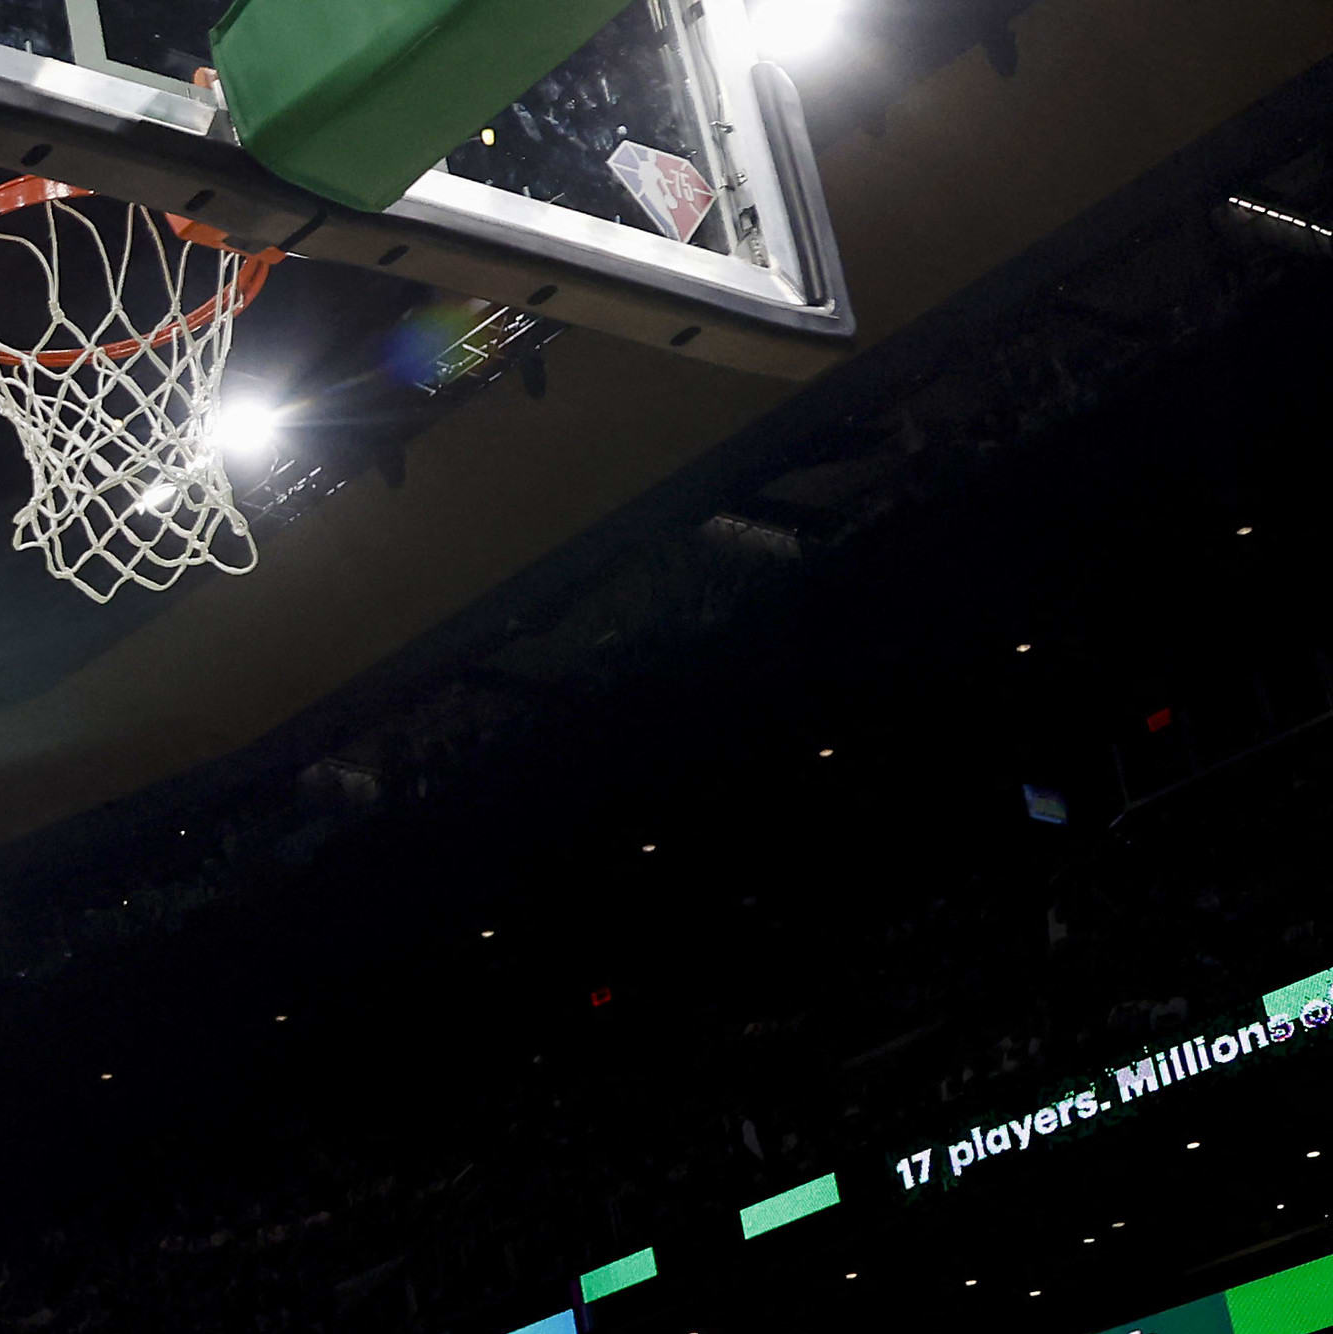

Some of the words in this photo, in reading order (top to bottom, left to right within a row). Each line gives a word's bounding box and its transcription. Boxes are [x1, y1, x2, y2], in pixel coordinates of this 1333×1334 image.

[897, 1148, 931, 1190] 17
[948, 1090, 1111, 1176] players.
[1115, 1014, 1294, 1104] Millions
